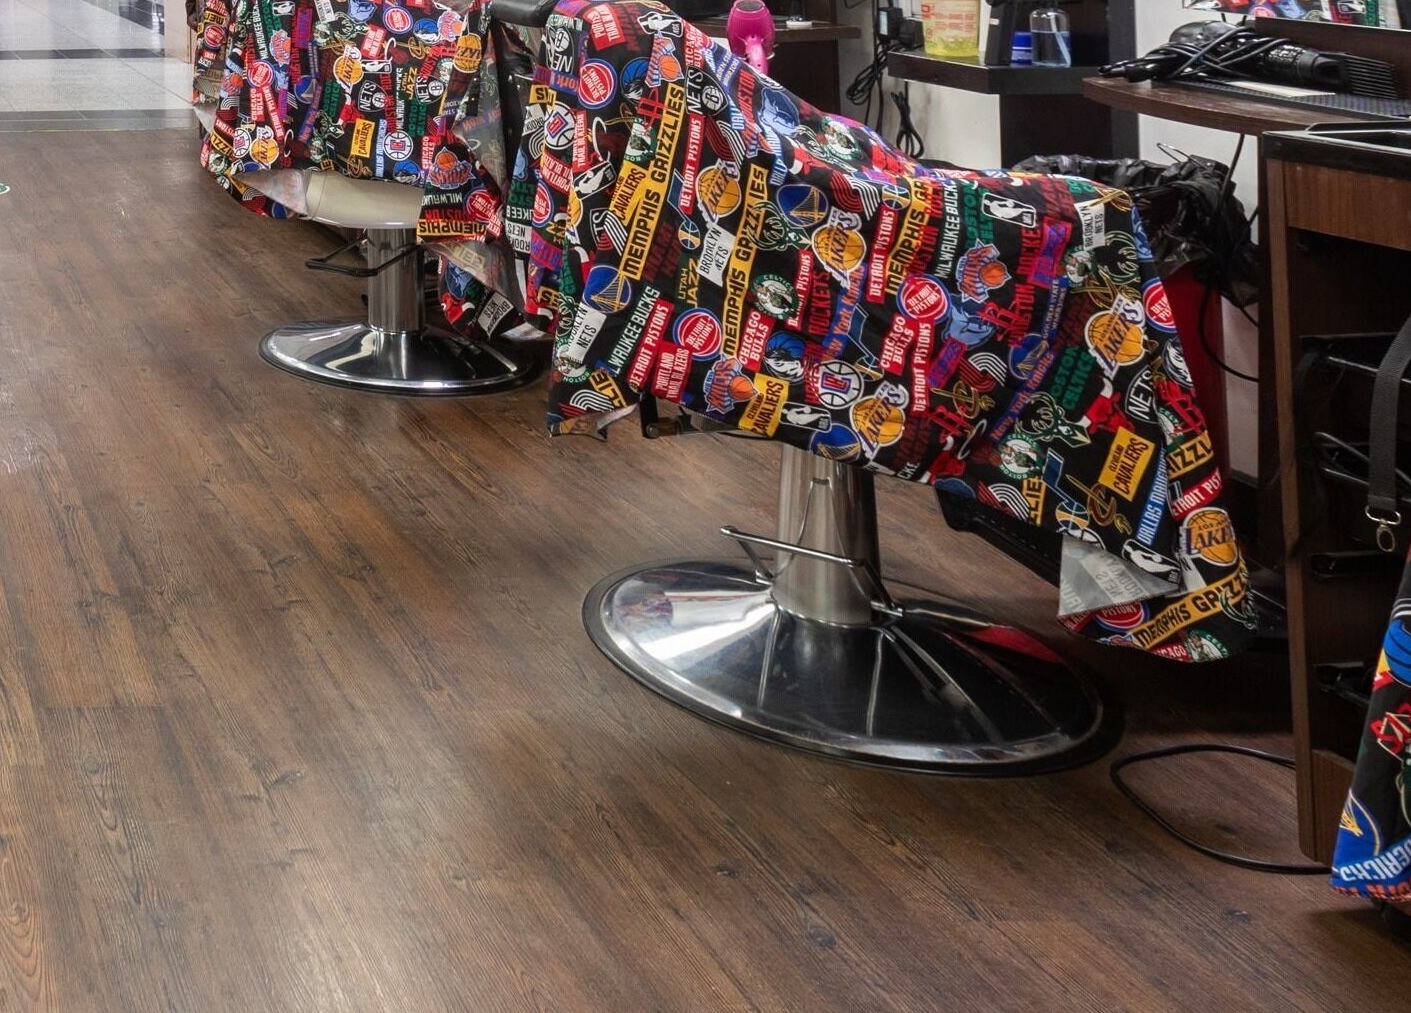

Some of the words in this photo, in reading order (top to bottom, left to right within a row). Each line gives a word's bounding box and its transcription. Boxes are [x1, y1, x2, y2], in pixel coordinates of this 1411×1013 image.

[359, 81, 376, 111] NETS
[406, 66, 418, 100] JAZZ
[416, 76, 429, 104] NETS
[583, 72, 599, 100] DETROIT
[686, 68, 704, 114] NETS
[358, 121, 372, 156] CAVALIERS
[688, 118, 702, 161] PISTONS
[613, 167, 646, 220] CAVALIERS
[623, 189, 661, 275] MEMPHIS
[650, 87, 684, 183] GRIZZLIES
[681, 166, 696, 206] DETROIT
[418, 221, 487, 235] MEMPHIS
[875, 210, 895, 252] PISTONS
[1080, 205, 1094, 248] BROOKLYN
[1094, 213, 1103, 234] NETS
[885, 208, 926, 294] MEMPHIS
[934, 216, 961, 279] MILWAUKEE
[678, 267, 689, 300] UTAH
[686, 260, 700, 306] JAZZ
[797, 254, 813, 291] PISTONS
[869, 252, 884, 297] DETROIT
[635, 286, 660, 329] BUCKS
[723, 267, 746, 356] MEMPHIS
[808, 271, 832, 336] ROCKETS
[907, 285, 934, 309] DETROIT
[914, 292, 941, 313] PISTONS
[578, 324, 597, 349] NETS
[649, 304, 669, 346] PISTONS
[686, 318, 706, 346] DETROIT
[692, 323, 715, 350] PISTONS
[740, 311, 762, 365] CHICAGO
[750, 323, 770, 362] BULLS
[880, 316, 906, 369] CHICAGO
[892, 328, 915, 364] BULLS
[914, 322, 931, 364] PISTONS
[1093, 300, 1144, 373] LAKERS
[656, 351, 675, 392] PORTLAND
[666, 375, 680, 399] TRAIL
[673, 347, 690, 377] BLAZERS
[913, 367, 927, 412] DETROIT
[1062, 353, 1094, 410] CELTICS
[753, 380, 785, 436] CAVALIERS
[1128, 369, 1154, 420] NETS
[1007, 434, 1038, 448] CELTICS
[999, 464, 1028, 480] BOSTON
[1113, 438, 1150, 495] CAVALIERS
[1137, 506, 1164, 546] DALLAS
[1136, 605, 1190, 646] MEMPHIS
